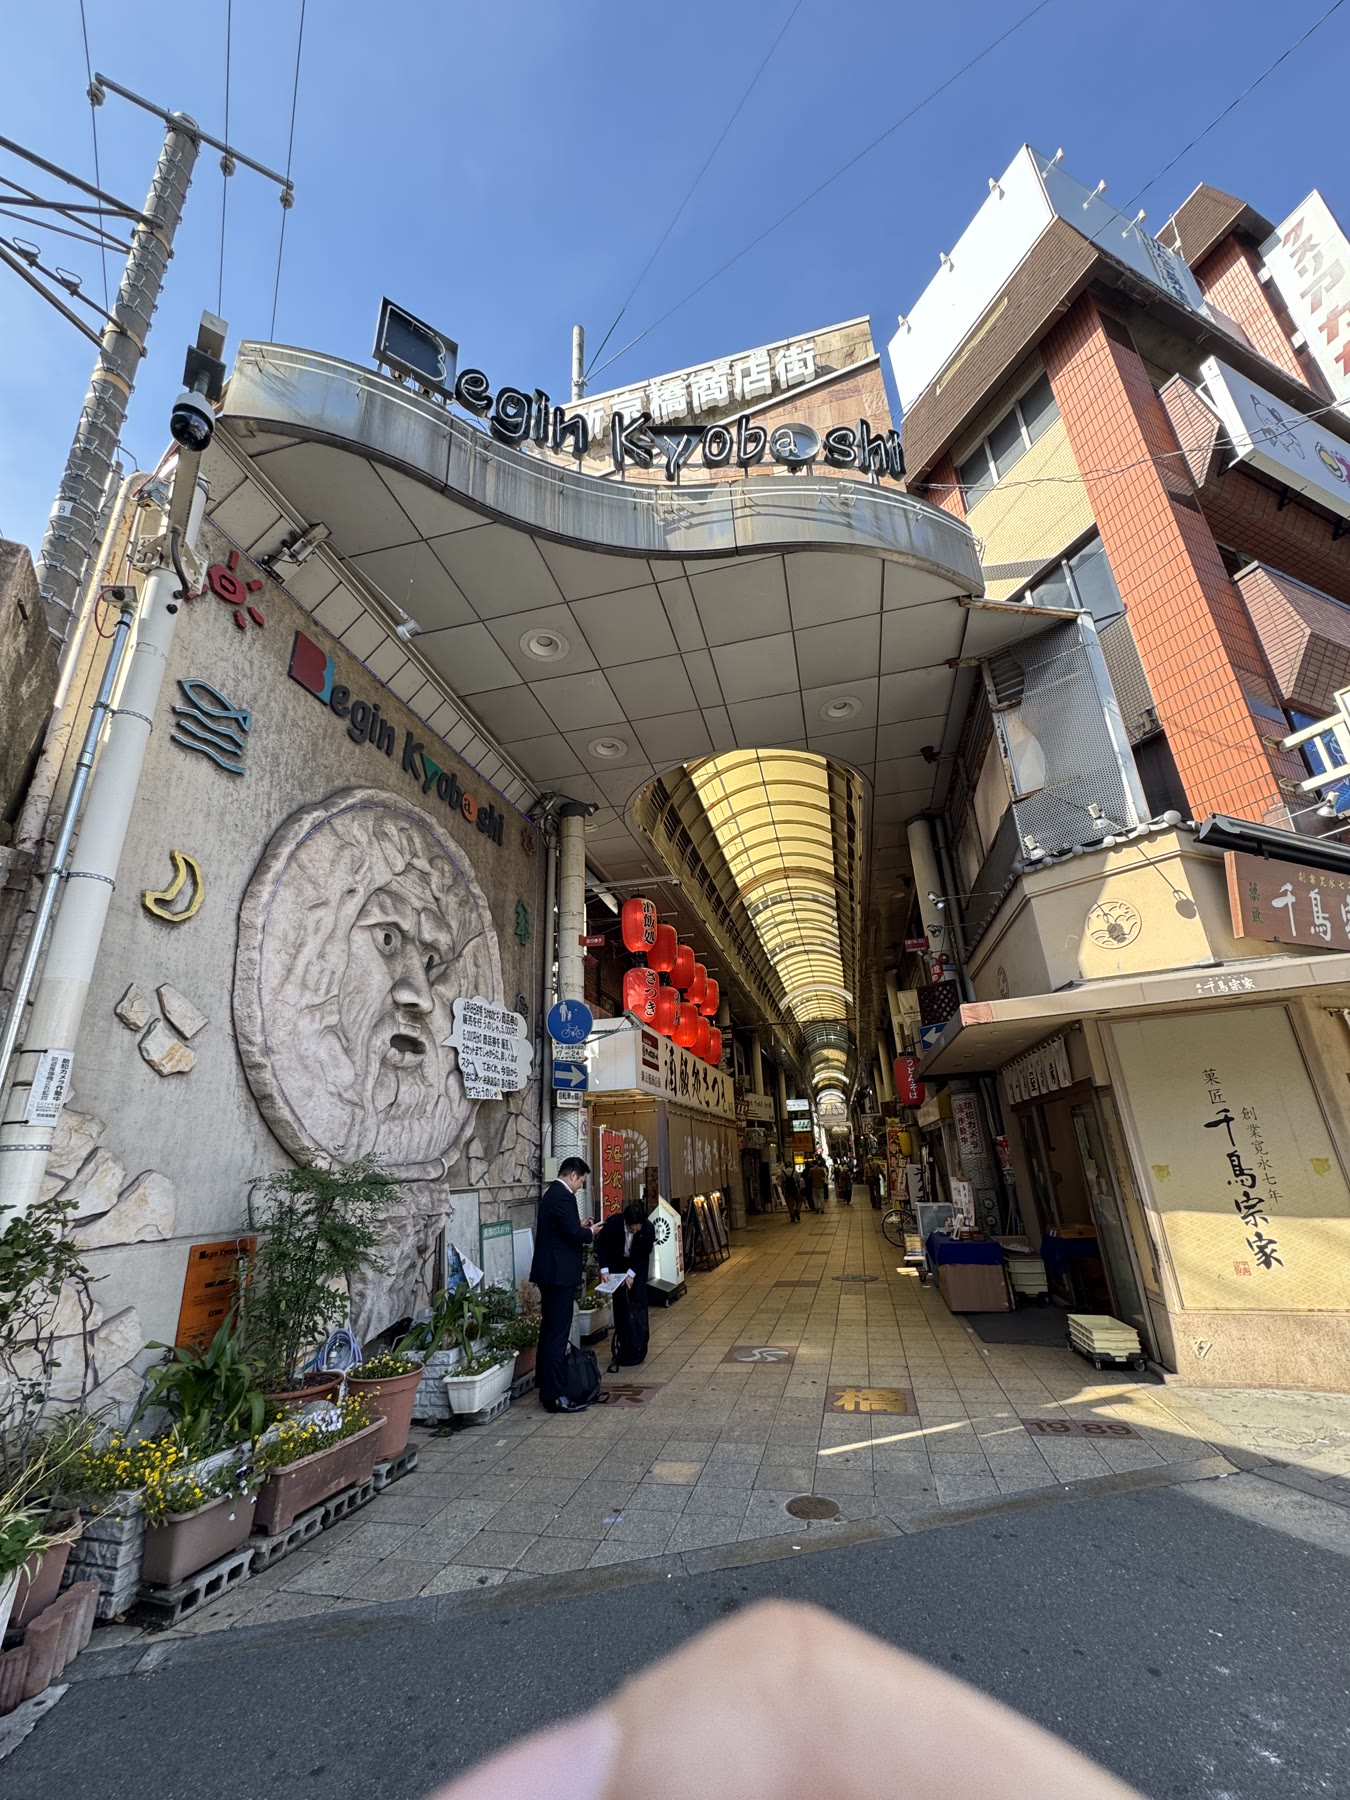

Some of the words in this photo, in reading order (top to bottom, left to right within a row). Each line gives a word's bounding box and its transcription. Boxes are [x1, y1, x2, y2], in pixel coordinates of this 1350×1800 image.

[378, 300, 590, 461] Begin
[611, 411, 907, 482] Kyobashi
[288, 630, 396, 757] Begin
[402, 731, 505, 847] Kyobashi
[645, 970, 657, 1017] さつき
[1203, 977, 1256, 993] 千鳥宗家
[1202, 1068, 1227, 1104] 菓匠
[1203, 1108, 1284, 1270] 千鳥宗家
[1240, 1107, 1283, 1204] 創業寛永七年
[834, 1388, 907, 1412] 橋
